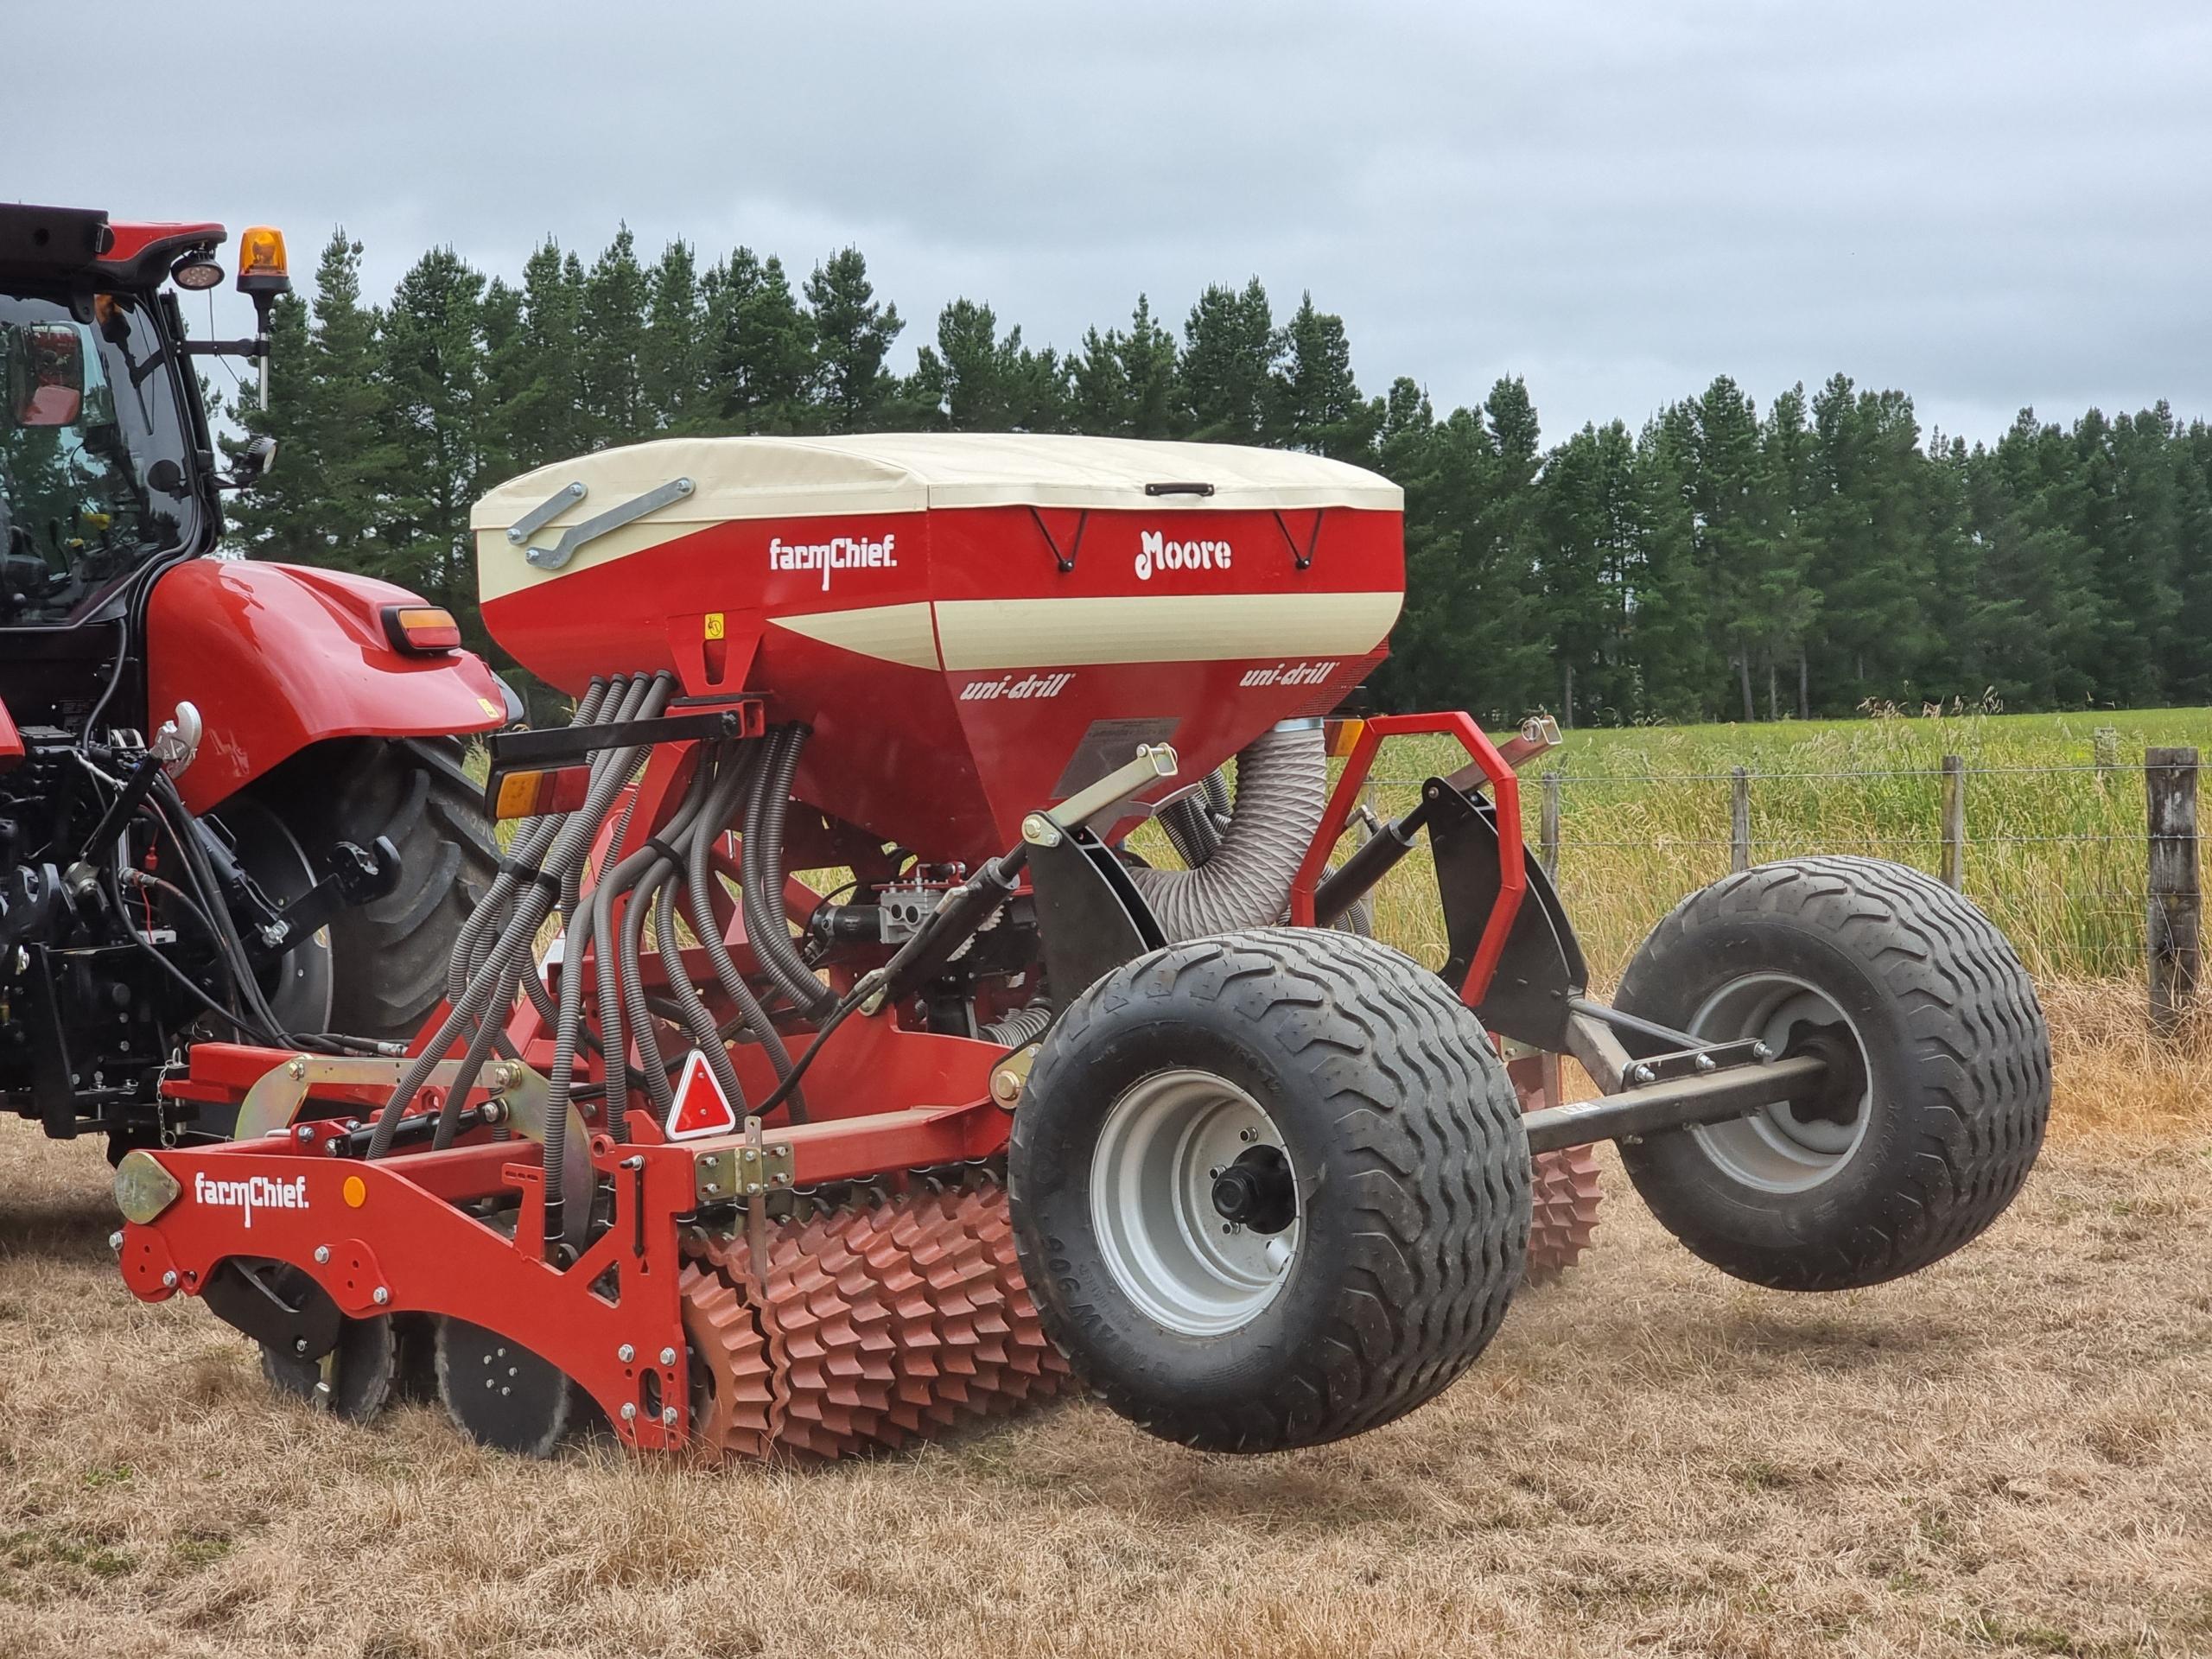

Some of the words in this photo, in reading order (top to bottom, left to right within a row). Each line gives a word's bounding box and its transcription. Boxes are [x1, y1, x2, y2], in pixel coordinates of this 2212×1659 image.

[1135, 531, 1231, 581] Moore
[959, 673, 1072, 701] uni-drill
[1239, 661, 1336, 687] uni-drill
